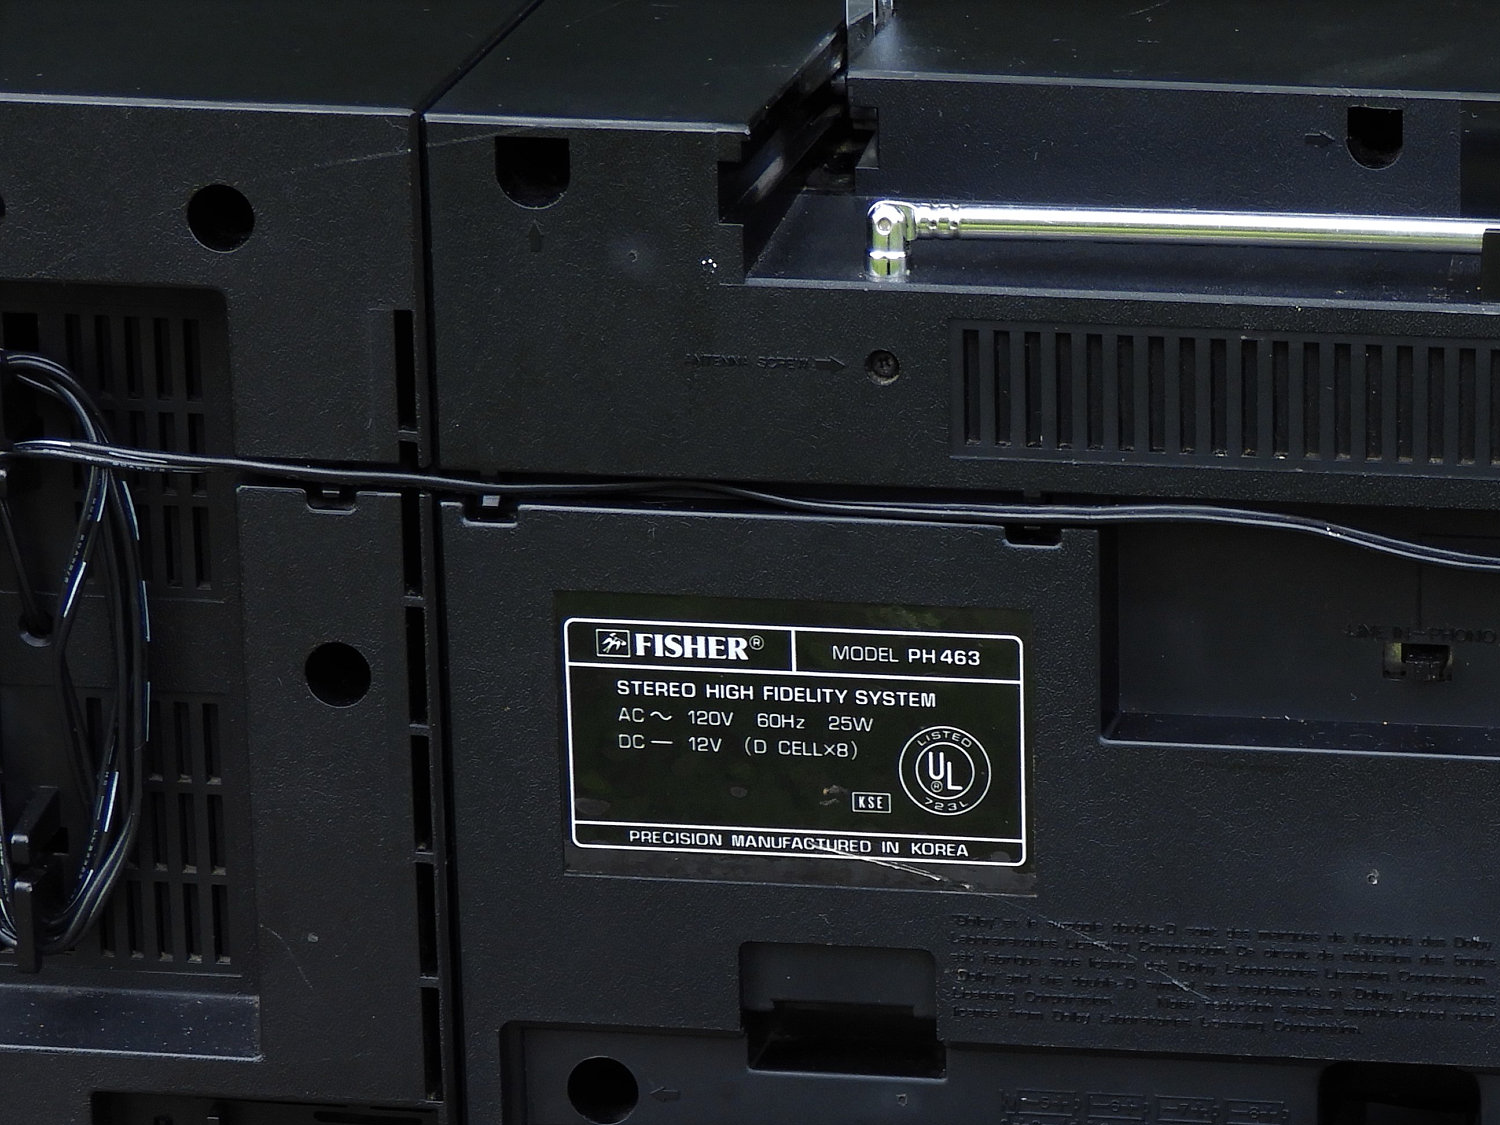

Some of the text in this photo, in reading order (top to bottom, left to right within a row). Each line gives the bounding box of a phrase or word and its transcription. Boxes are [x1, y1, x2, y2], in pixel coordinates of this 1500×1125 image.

[832, 645, 899, 663] MODEL
[617, 680, 936, 708] STEREO HIGH FIDELITY SYSTEM
[618, 707, 874, 732] AC 120V 60Hz 25W
[618, 733, 645, 749] DC
[688, 736, 722, 753] 12V
[916, 730, 972, 748] LISTED
[858, 795, 885, 811] KSE
[629, 830, 969, 857] PRECISION MANUFACTURED IN KOREA
